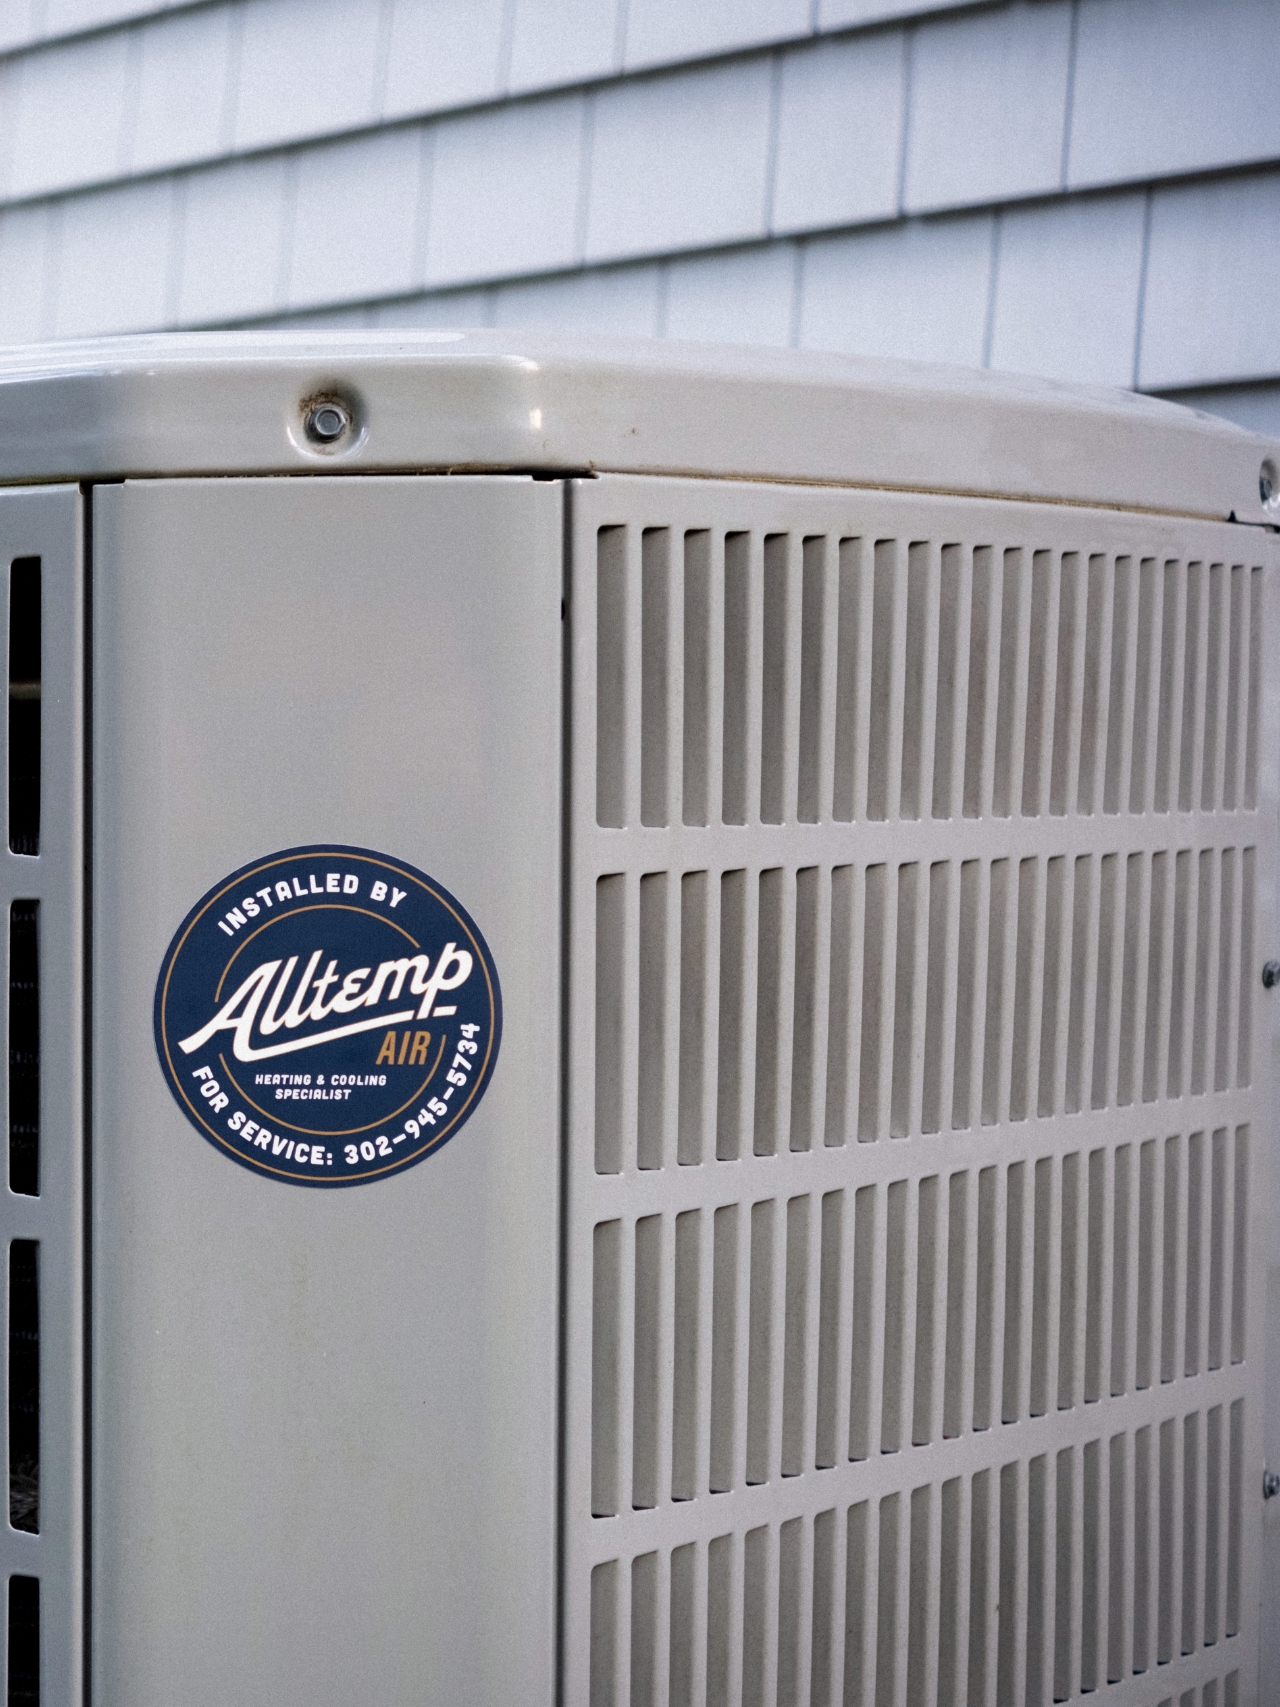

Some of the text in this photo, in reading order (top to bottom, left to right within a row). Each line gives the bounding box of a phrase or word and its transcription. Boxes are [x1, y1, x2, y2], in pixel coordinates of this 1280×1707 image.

[218, 873, 407, 936] INSTALLED BY
[177, 942, 473, 1063] Alltemp
[375, 1031, 431, 1065] AIR
[192, 1023, 481, 1166] FOR SERVICE: 302-945-5734
[255, 1074, 387, 1087] HEATING & COOLING
[275, 1089, 352, 1101] SPECIALIST
